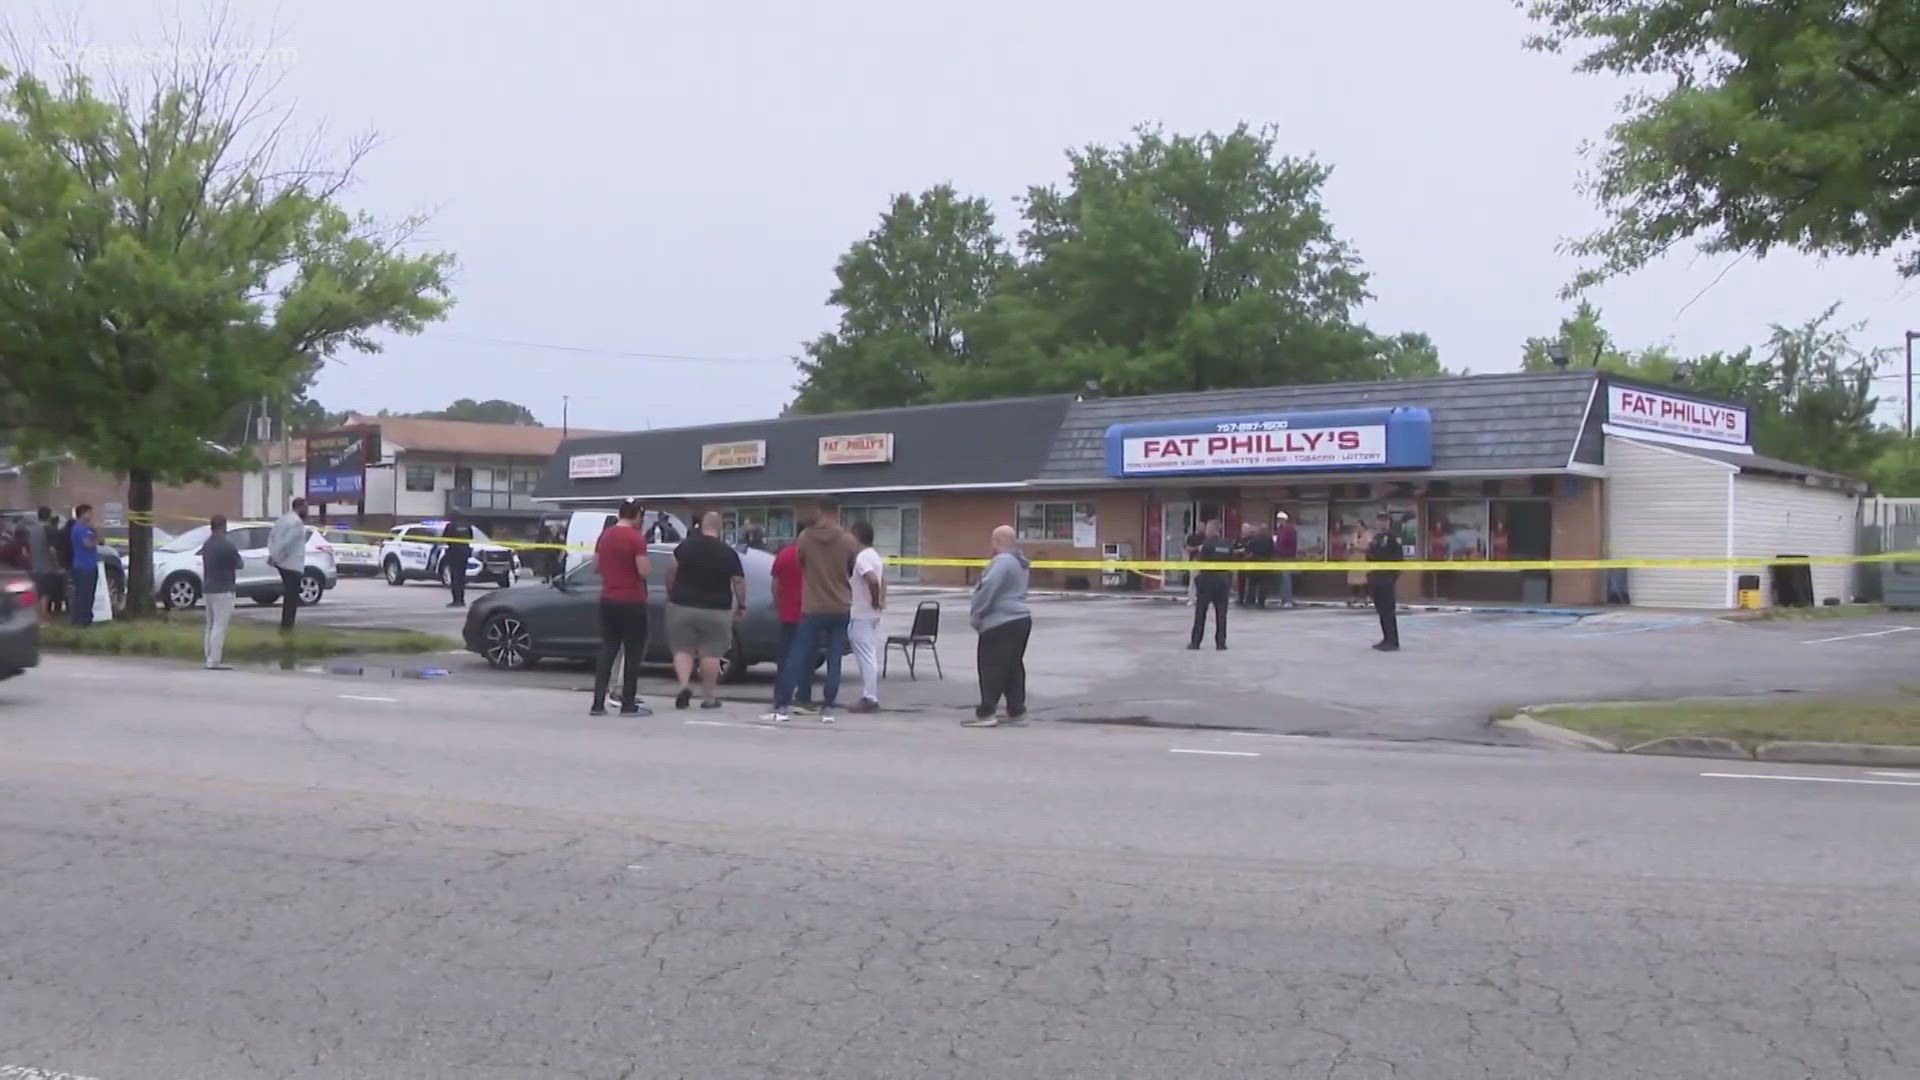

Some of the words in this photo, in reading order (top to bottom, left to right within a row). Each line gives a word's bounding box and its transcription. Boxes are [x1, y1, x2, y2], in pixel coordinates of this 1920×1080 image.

[1621, 392, 1656, 416] FAT
[1661, 400, 1736, 430] PHILLY'S
[1143, 439, 1199, 458] FAT
[1208, 431, 1360, 455] PHILLY'S
